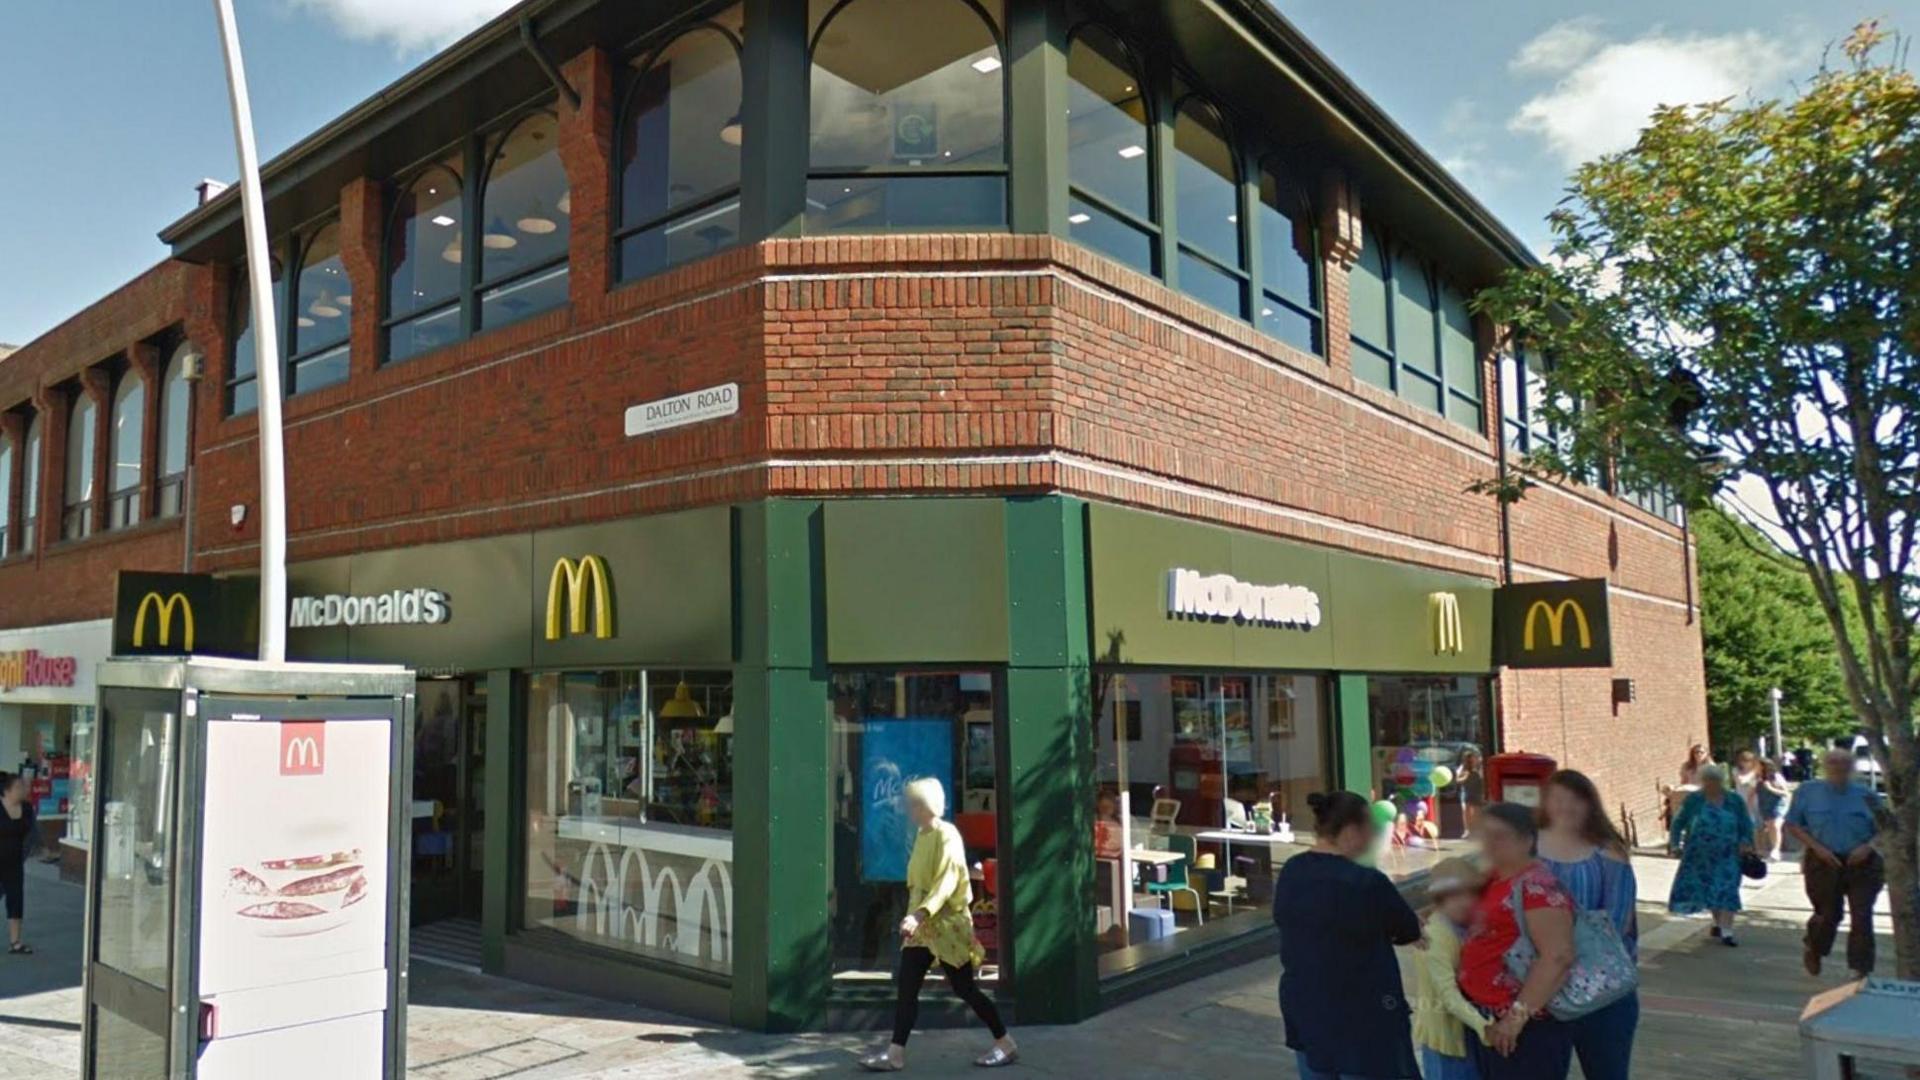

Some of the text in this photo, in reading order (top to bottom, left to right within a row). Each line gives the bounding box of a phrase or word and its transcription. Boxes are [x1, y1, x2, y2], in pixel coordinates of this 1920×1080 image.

[646, 396, 691, 421] DALTON
[697, 387, 733, 409] ROAD
[290, 588, 446, 628] McDonald's
[0, 649, 76, 691] ghtHouse
